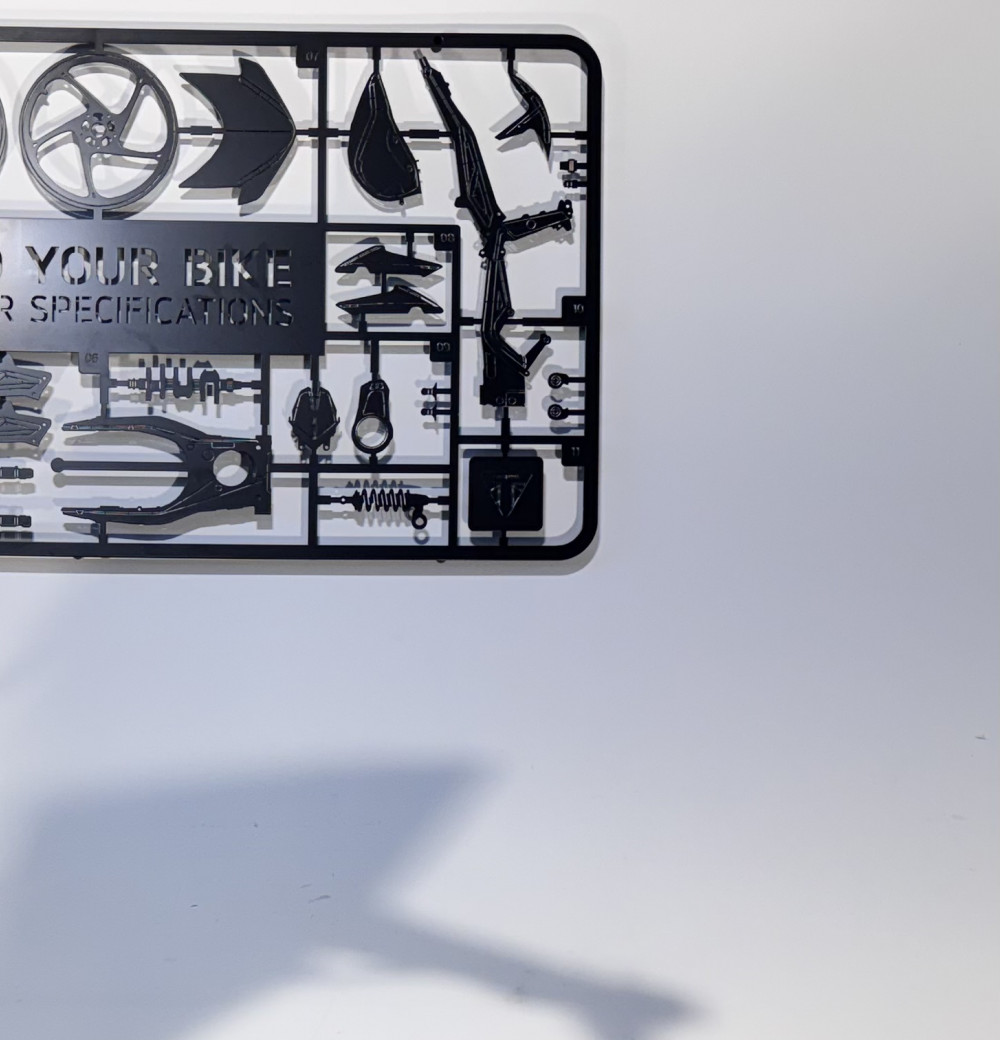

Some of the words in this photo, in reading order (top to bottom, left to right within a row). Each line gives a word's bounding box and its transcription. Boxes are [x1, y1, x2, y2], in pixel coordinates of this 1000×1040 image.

[25, 245, 159, 286] YOUR
[184, 248, 293, 288] BIKE
[30, 295, 294, 327] SPECIFICATIONS
